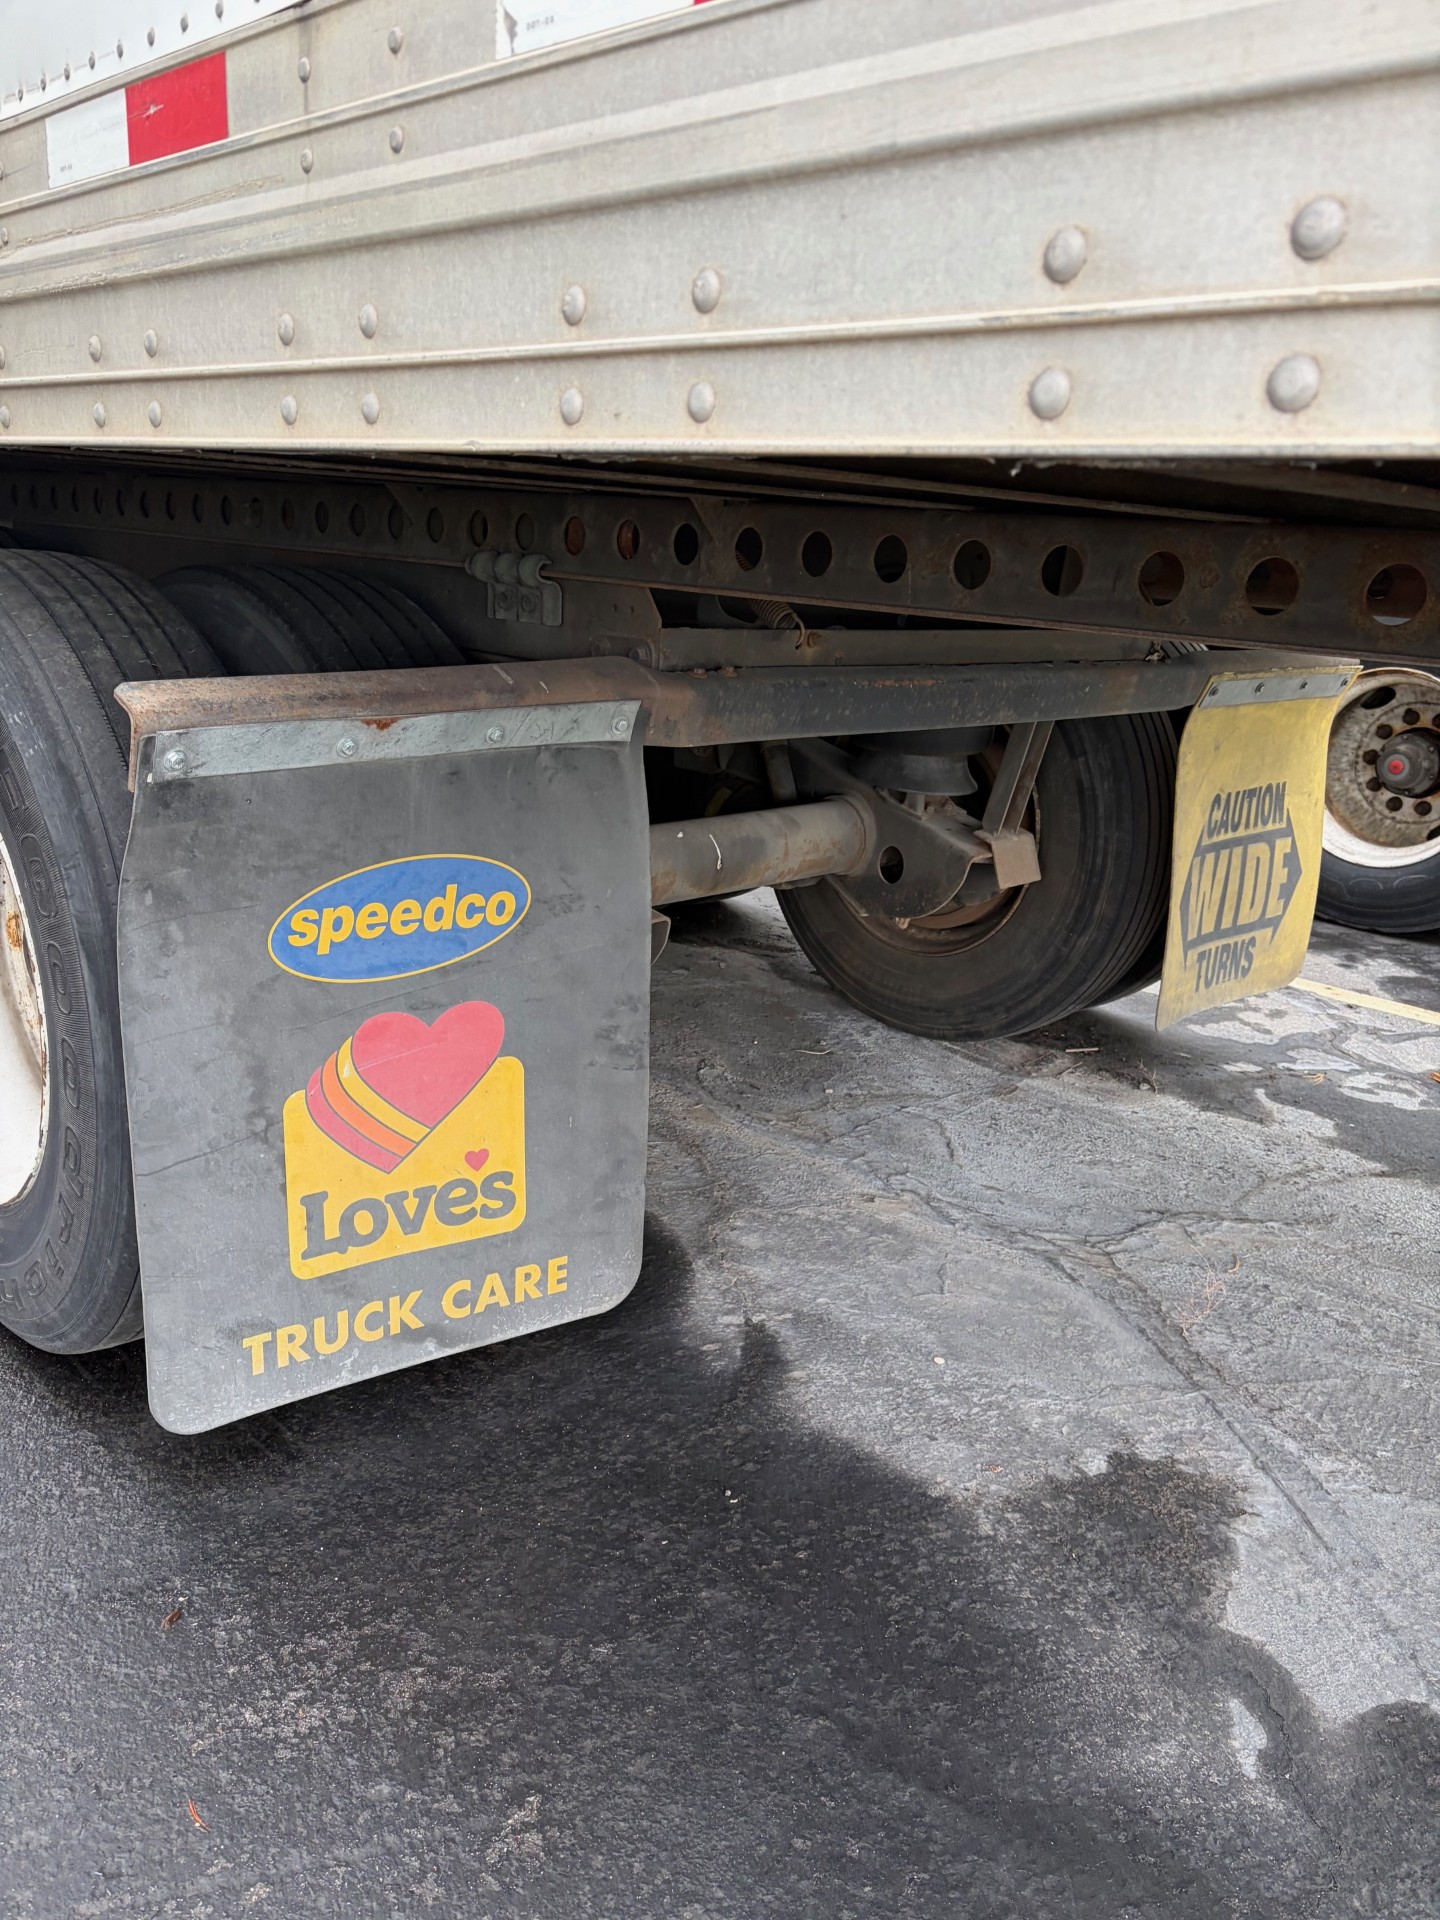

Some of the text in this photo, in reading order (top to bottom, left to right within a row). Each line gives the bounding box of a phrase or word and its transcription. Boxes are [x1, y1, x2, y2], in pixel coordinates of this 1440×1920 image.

[1207, 781, 1287, 840] CAUTION
[287, 882, 516, 954] speedco
[1187, 837, 1292, 942] WIDE
[1195, 936, 1256, 993] TURNS
[242, 1255, 569, 1377] TRUCK CARE
